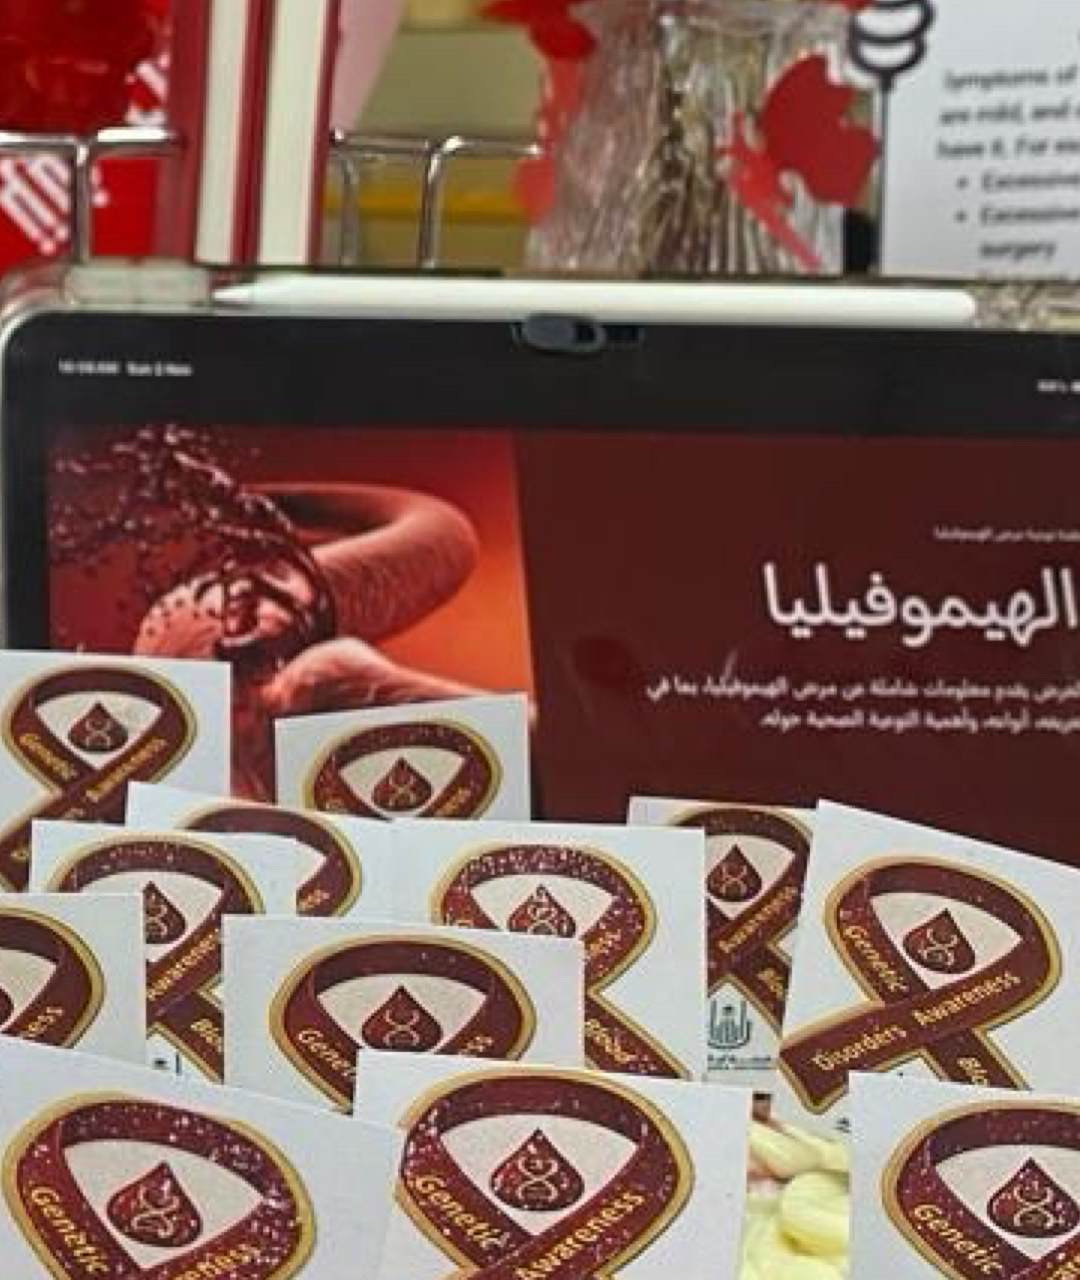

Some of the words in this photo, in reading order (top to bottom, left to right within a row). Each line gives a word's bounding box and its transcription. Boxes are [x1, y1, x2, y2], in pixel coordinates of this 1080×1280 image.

[762, 562, 1078, 648] الهيموفيليا
[843, 925, 909, 993] Genetic
[298, 1029, 357, 1078] Gene
[811, 1023, 908, 1072] Disorders
[910, 970, 1021, 1026] Awareness
[29, 1183, 111, 1274] Genetic
[414, 1173, 508, 1250] Genetic
[912, 1202, 1004, 1274] Genetic
